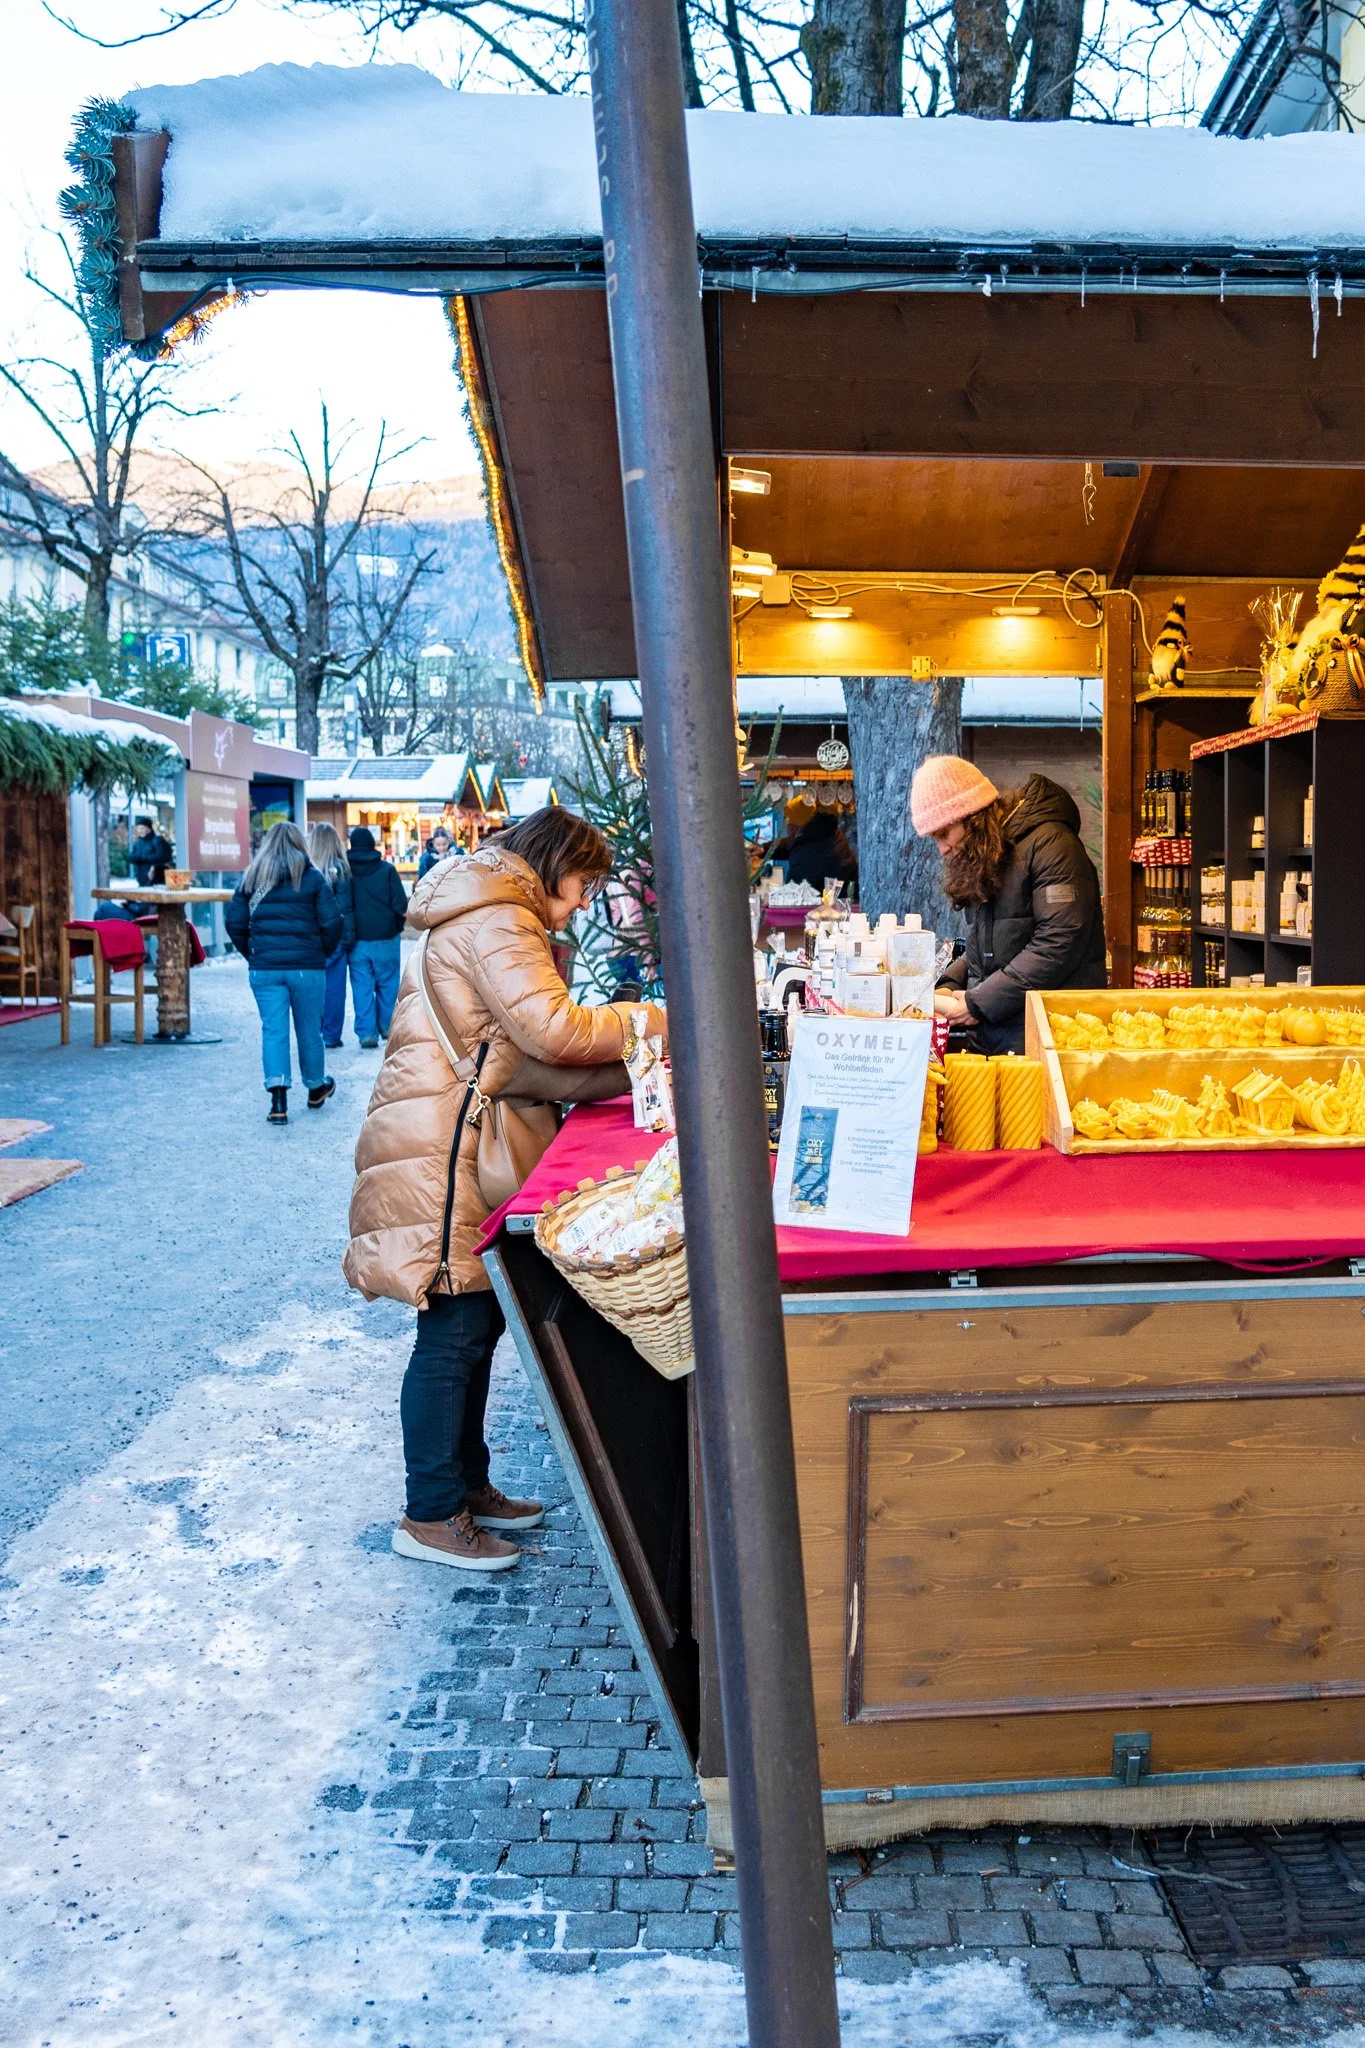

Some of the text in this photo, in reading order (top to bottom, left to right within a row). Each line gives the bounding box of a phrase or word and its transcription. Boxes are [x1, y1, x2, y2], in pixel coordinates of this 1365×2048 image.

[816, 1032, 908, 1051] OXYMEL
[824, 1052, 895, 1064] Das Getränk für Ihr
[833, 1063, 884, 1074] Wohlbefinden
[806, 1138, 825, 1148] OXY
[805, 1147, 824, 1157] MEL
